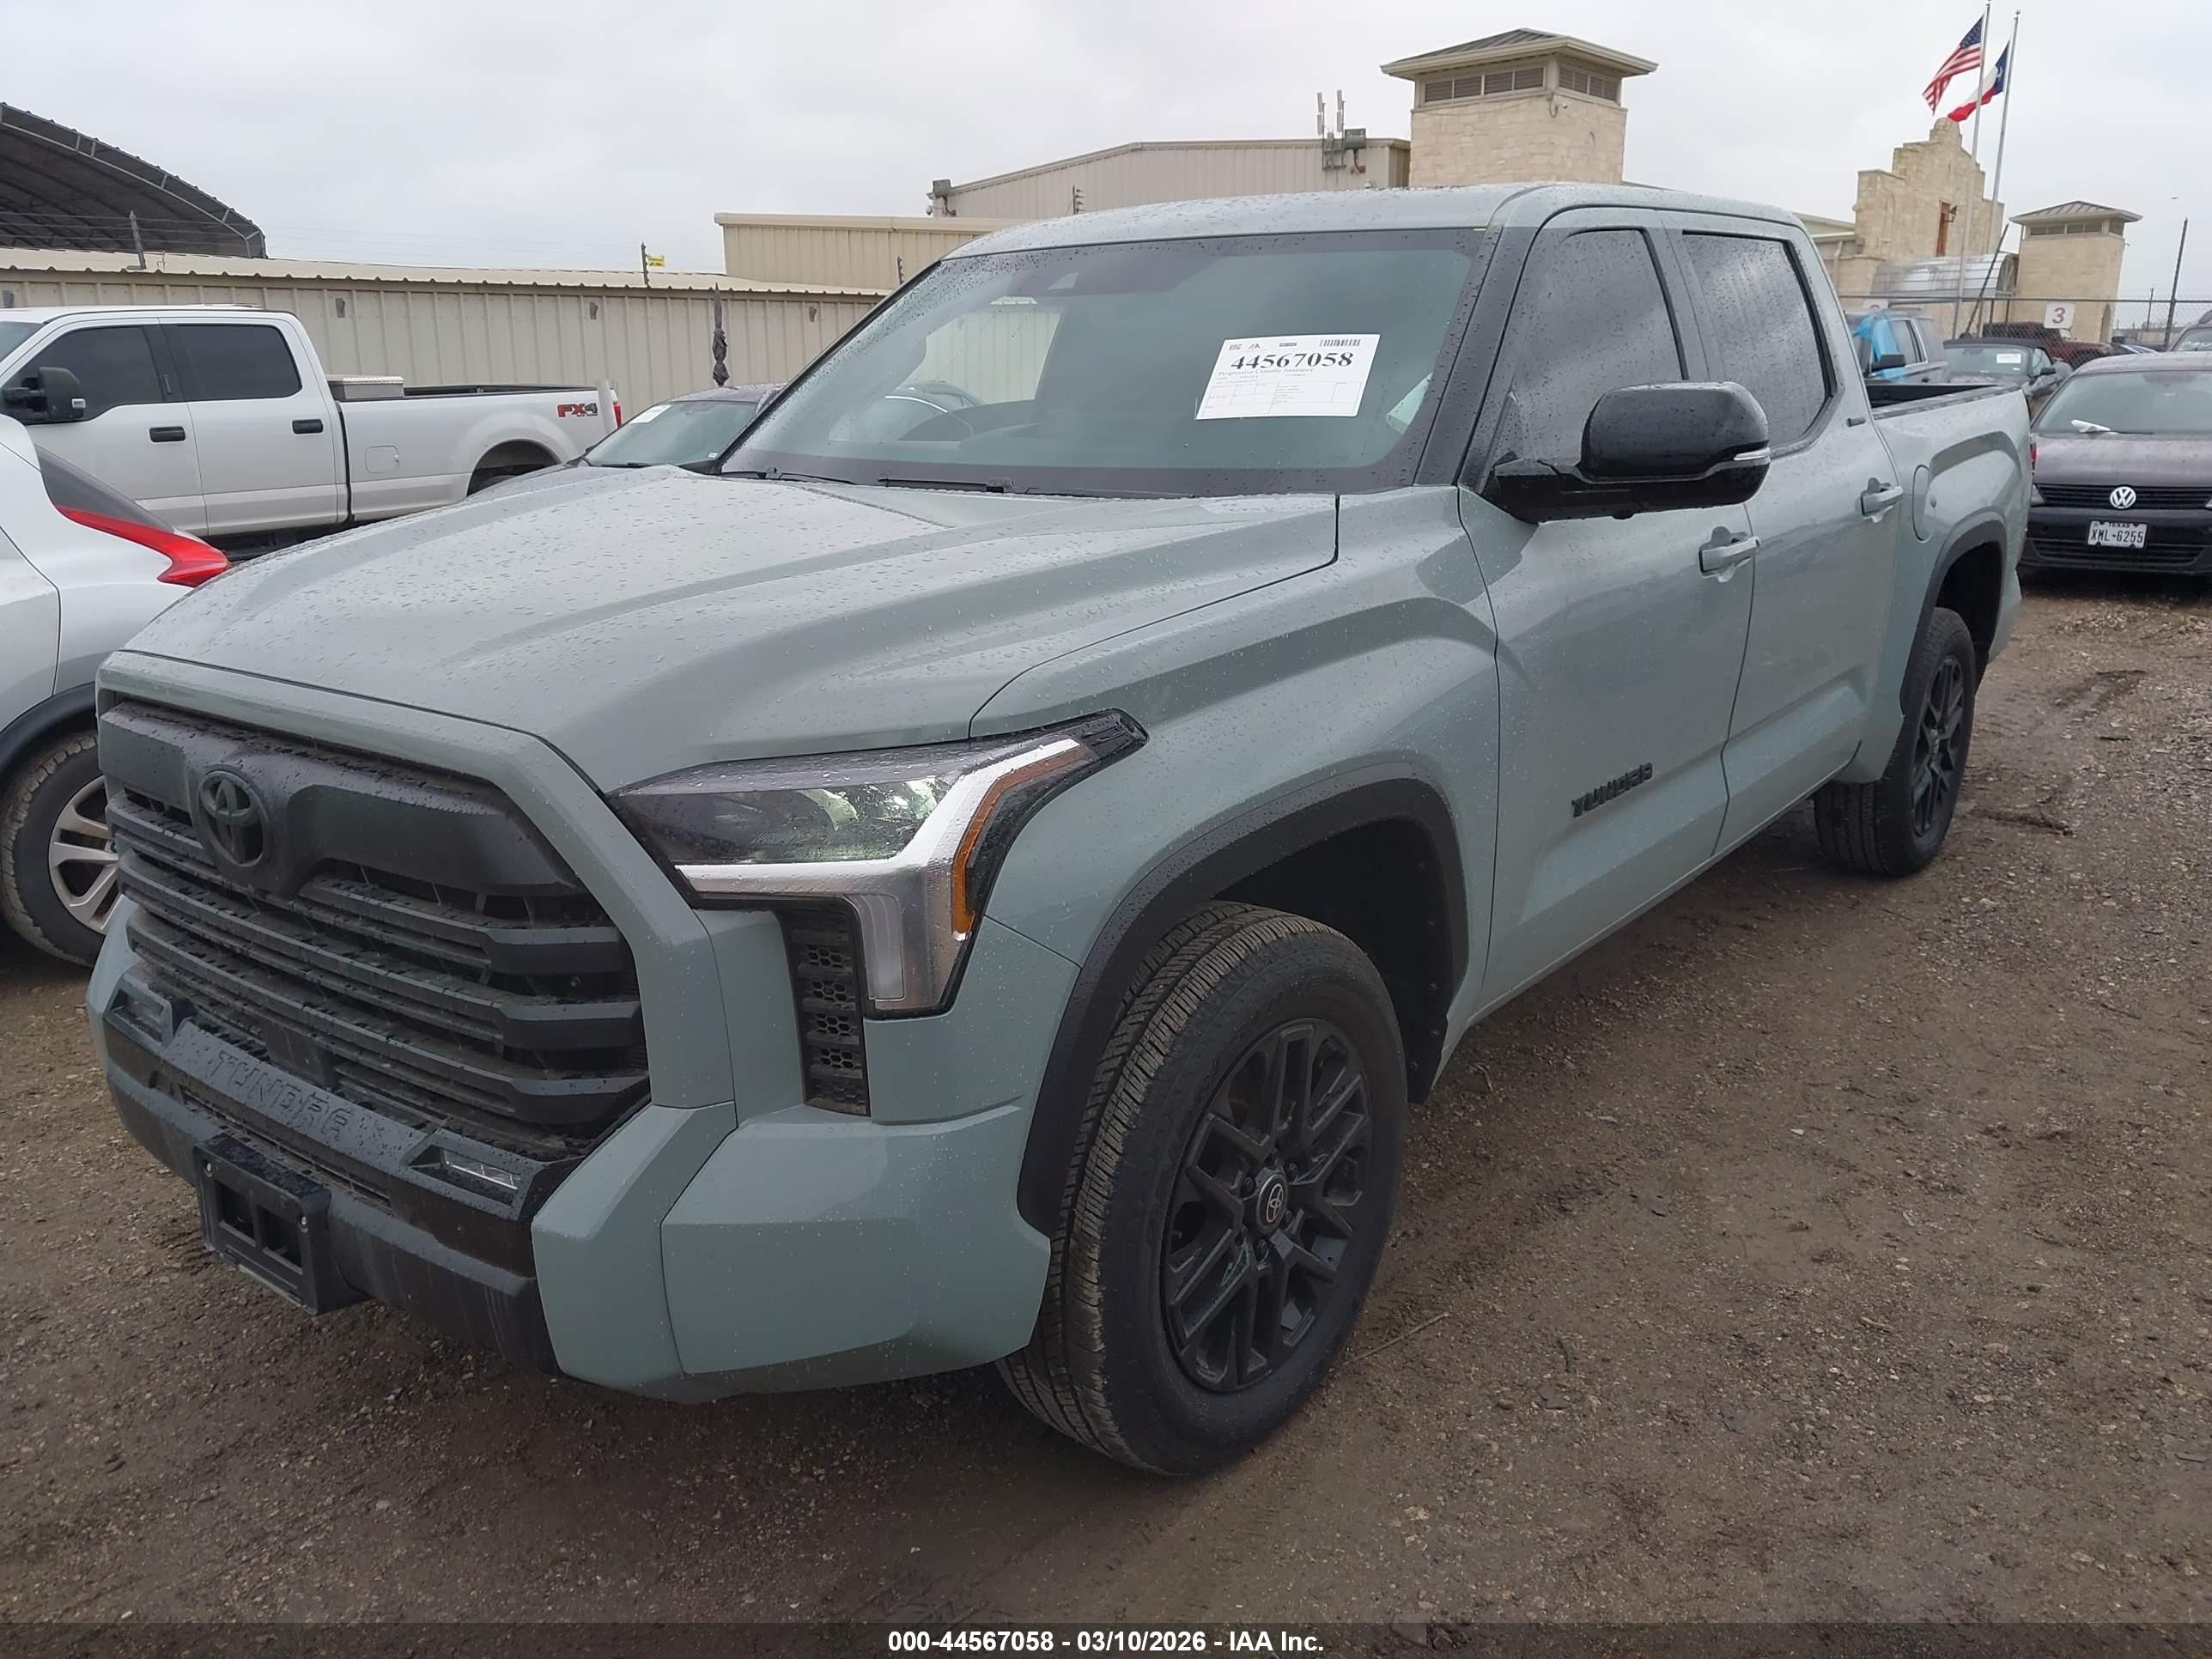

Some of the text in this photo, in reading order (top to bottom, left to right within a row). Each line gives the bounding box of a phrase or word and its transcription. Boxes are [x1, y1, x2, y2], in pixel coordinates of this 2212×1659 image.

[2052, 307, 2066, 324] 3
[1230, 352, 1354, 370] 44567058
[556, 403, 599, 418] FX4
[1571, 762, 1653, 818] TUNDRA
